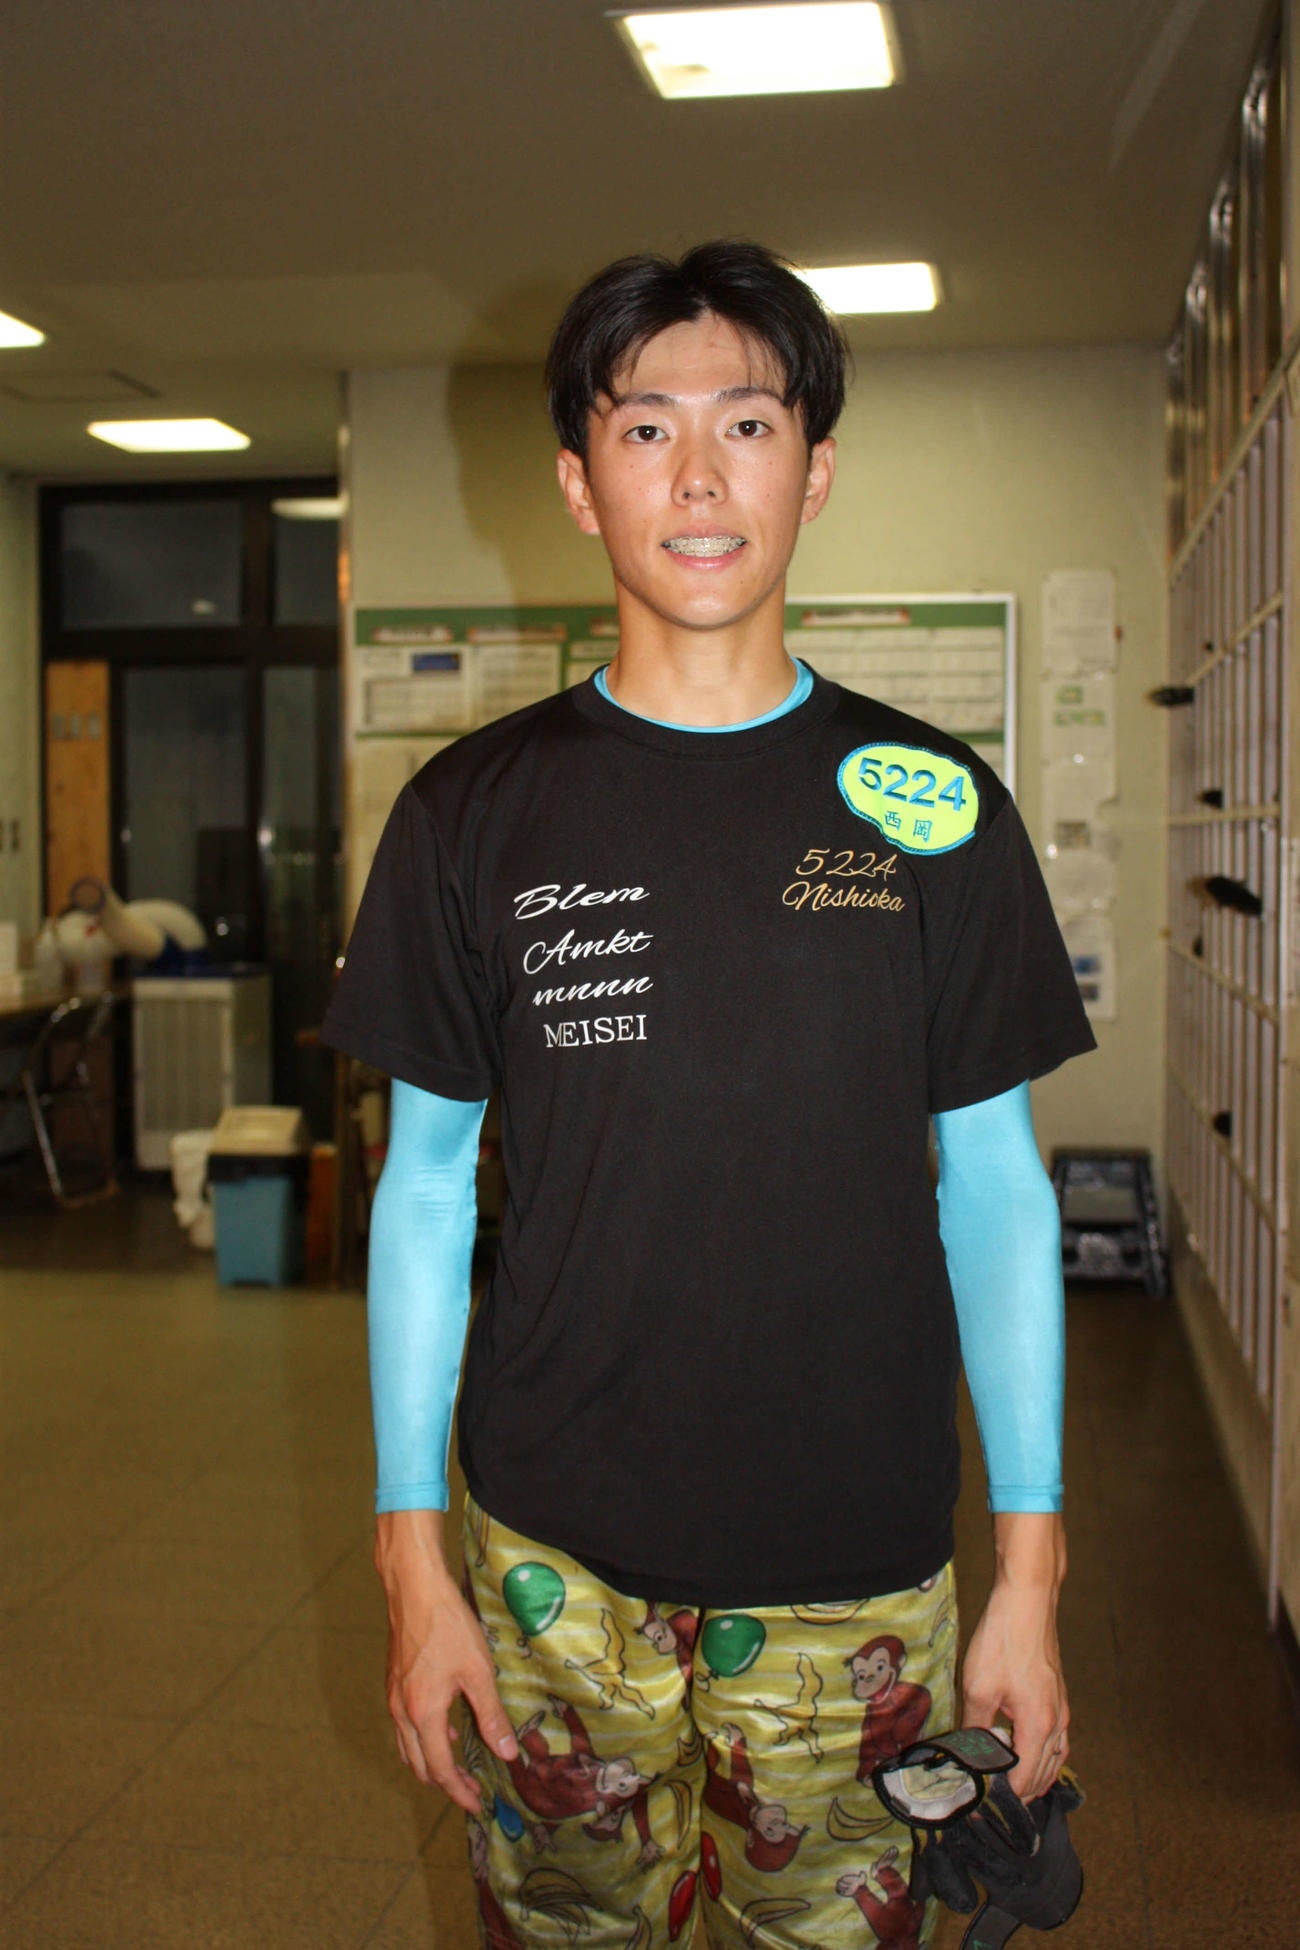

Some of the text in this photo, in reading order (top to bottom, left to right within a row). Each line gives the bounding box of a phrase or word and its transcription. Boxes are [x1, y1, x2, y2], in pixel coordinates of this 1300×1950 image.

[857, 757, 967, 811] 5224
[884, 810, 933, 843] 西岡
[795, 849, 898, 882] 5224
[513, 883, 650, 920] Blem
[782, 881, 905, 912] Nishioka
[523, 929, 654, 974] Amkt
[544, 1014, 648, 1048] MEISEI
